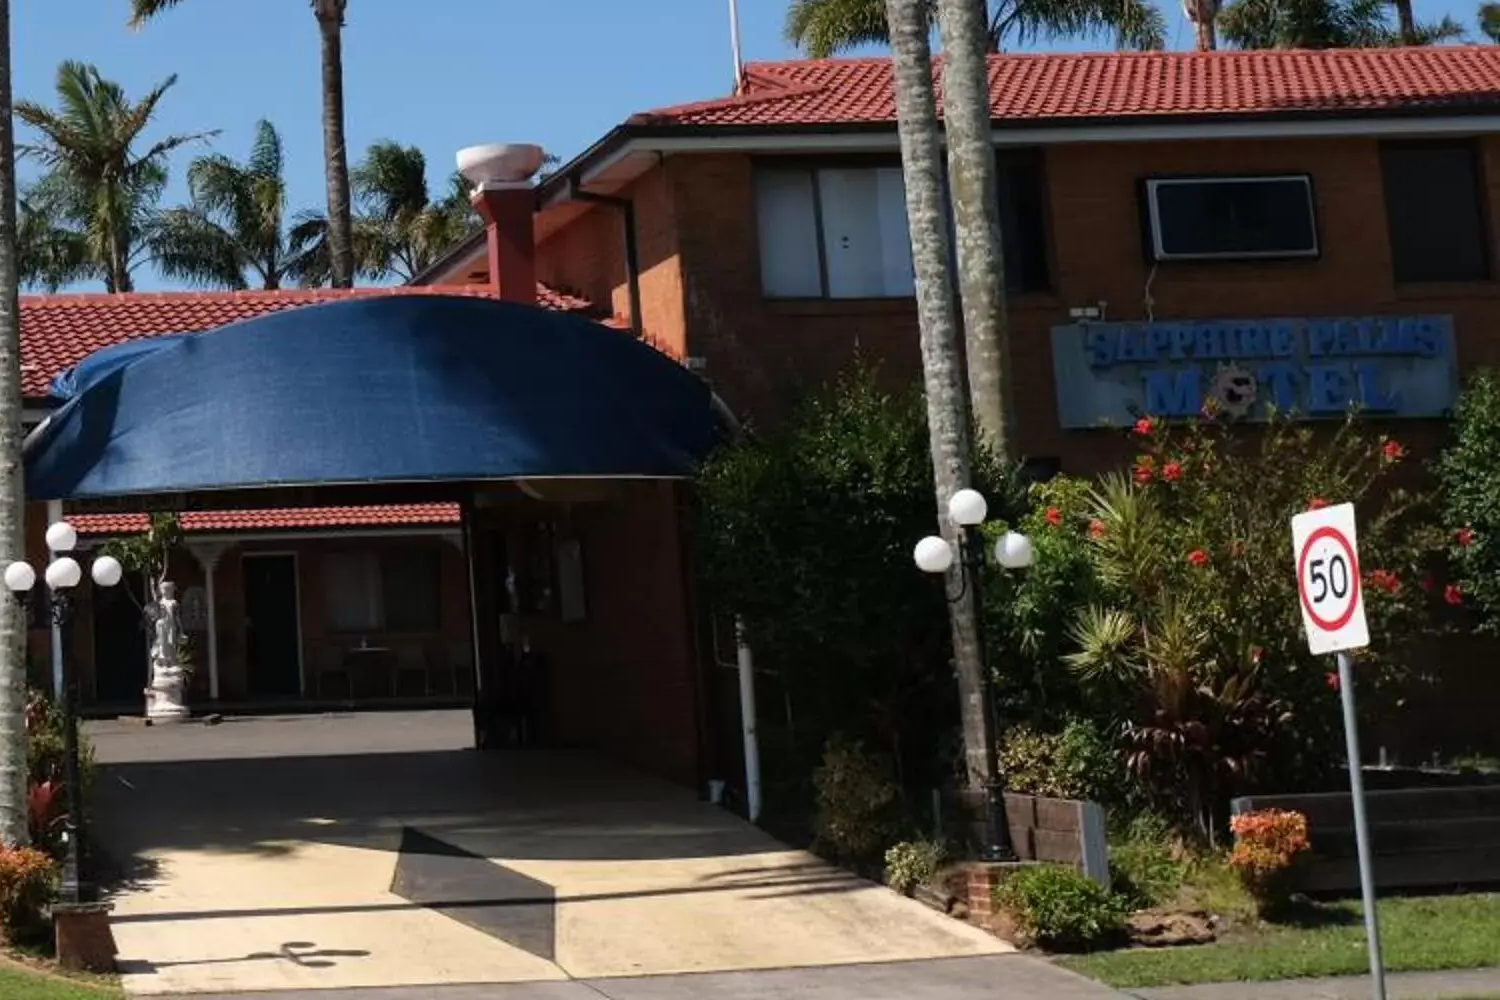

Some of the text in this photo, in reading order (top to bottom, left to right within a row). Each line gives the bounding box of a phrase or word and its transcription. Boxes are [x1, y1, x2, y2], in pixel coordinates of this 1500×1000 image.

[1087, 316, 1447, 366] SAPPHIRE PALMS
[1309, 553, 1348, 604] 50
